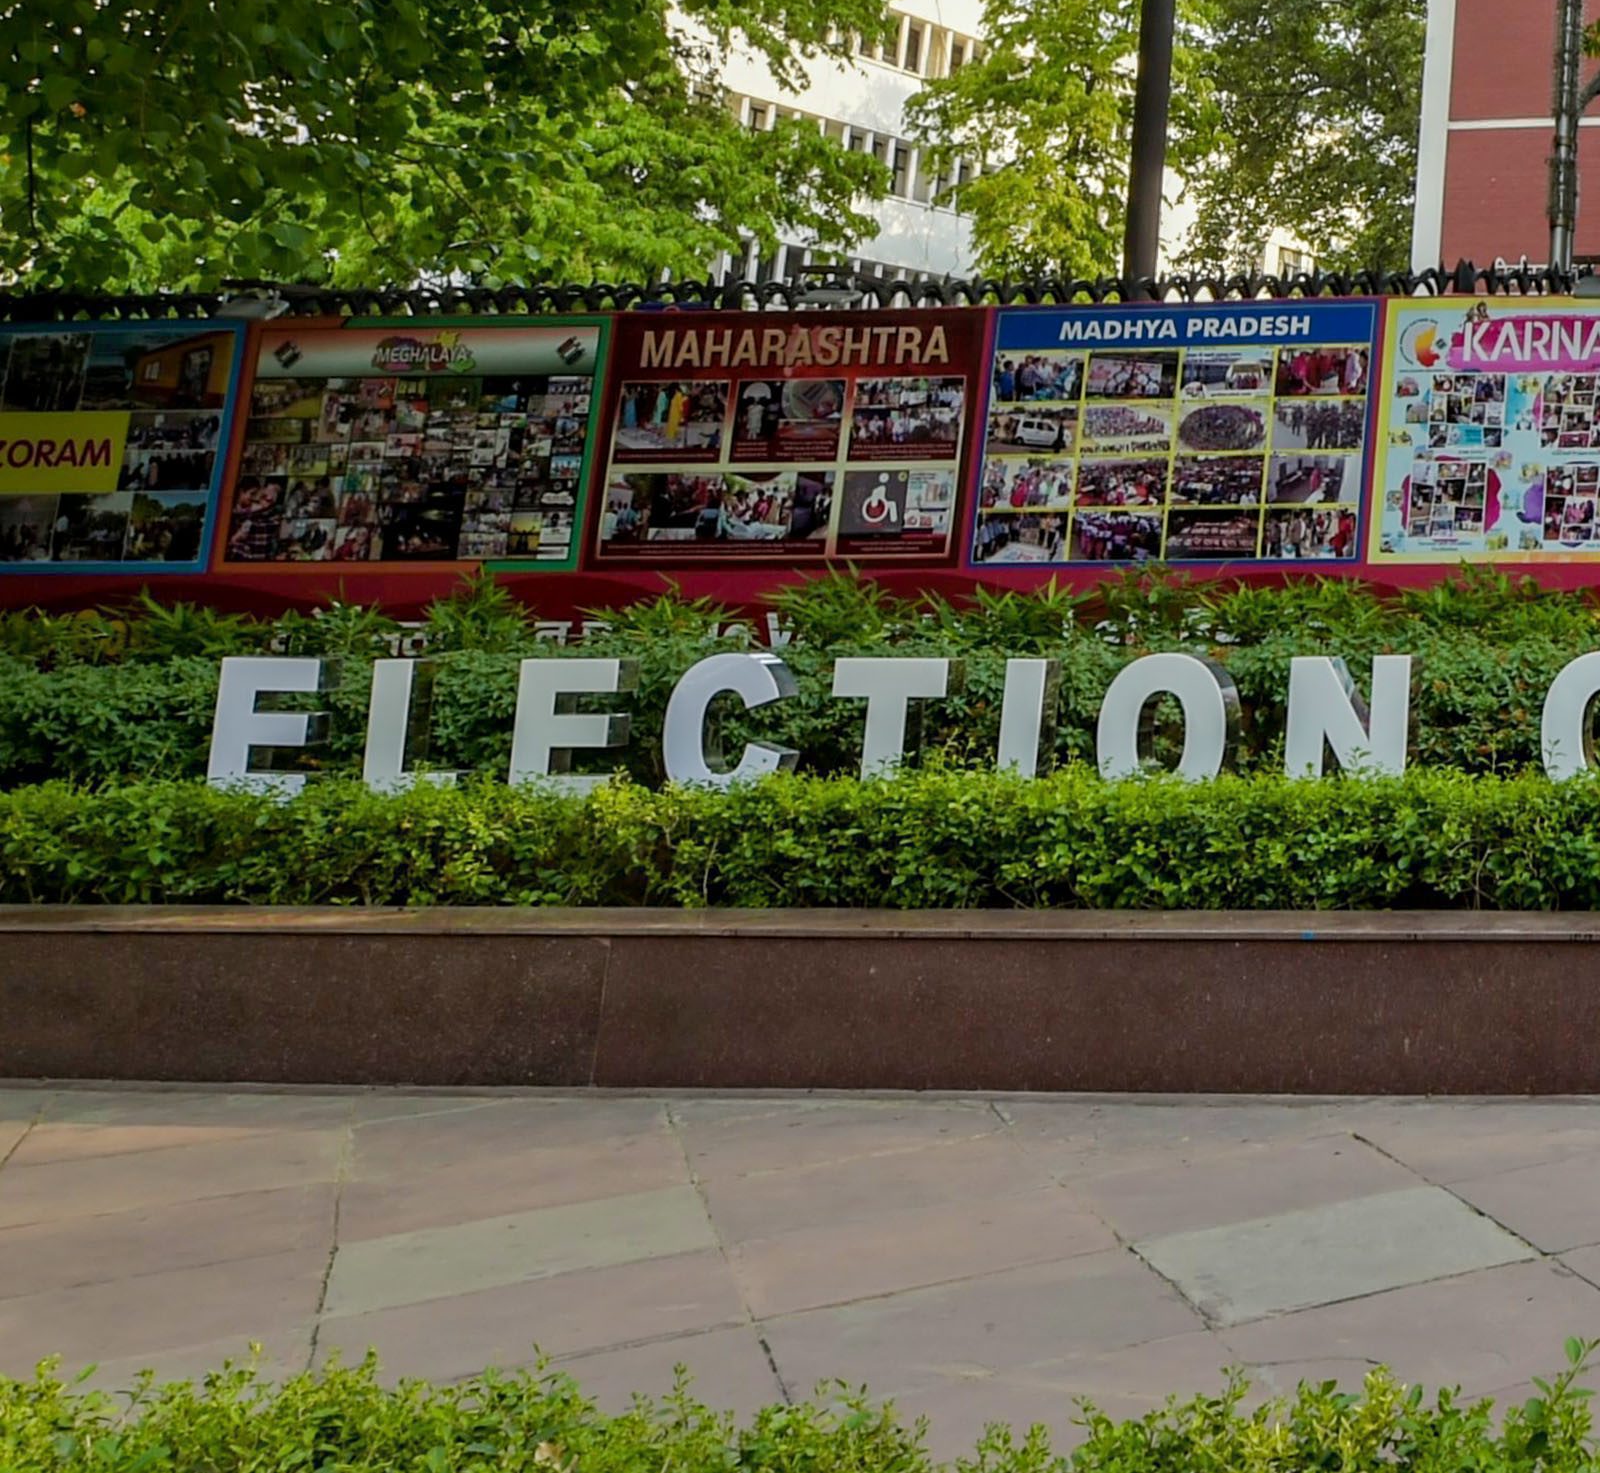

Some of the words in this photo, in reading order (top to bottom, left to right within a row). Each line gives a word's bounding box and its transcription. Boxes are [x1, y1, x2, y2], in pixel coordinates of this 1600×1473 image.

[1059, 318, 1178, 341] MADHYA
[1186, 315, 1311, 339] PRADESH
[376, 344, 468, 365] MEGHALAYA
[640, 325, 950, 368] MAHARASHTRA
[204, 652, 1420, 798] ELECTION
